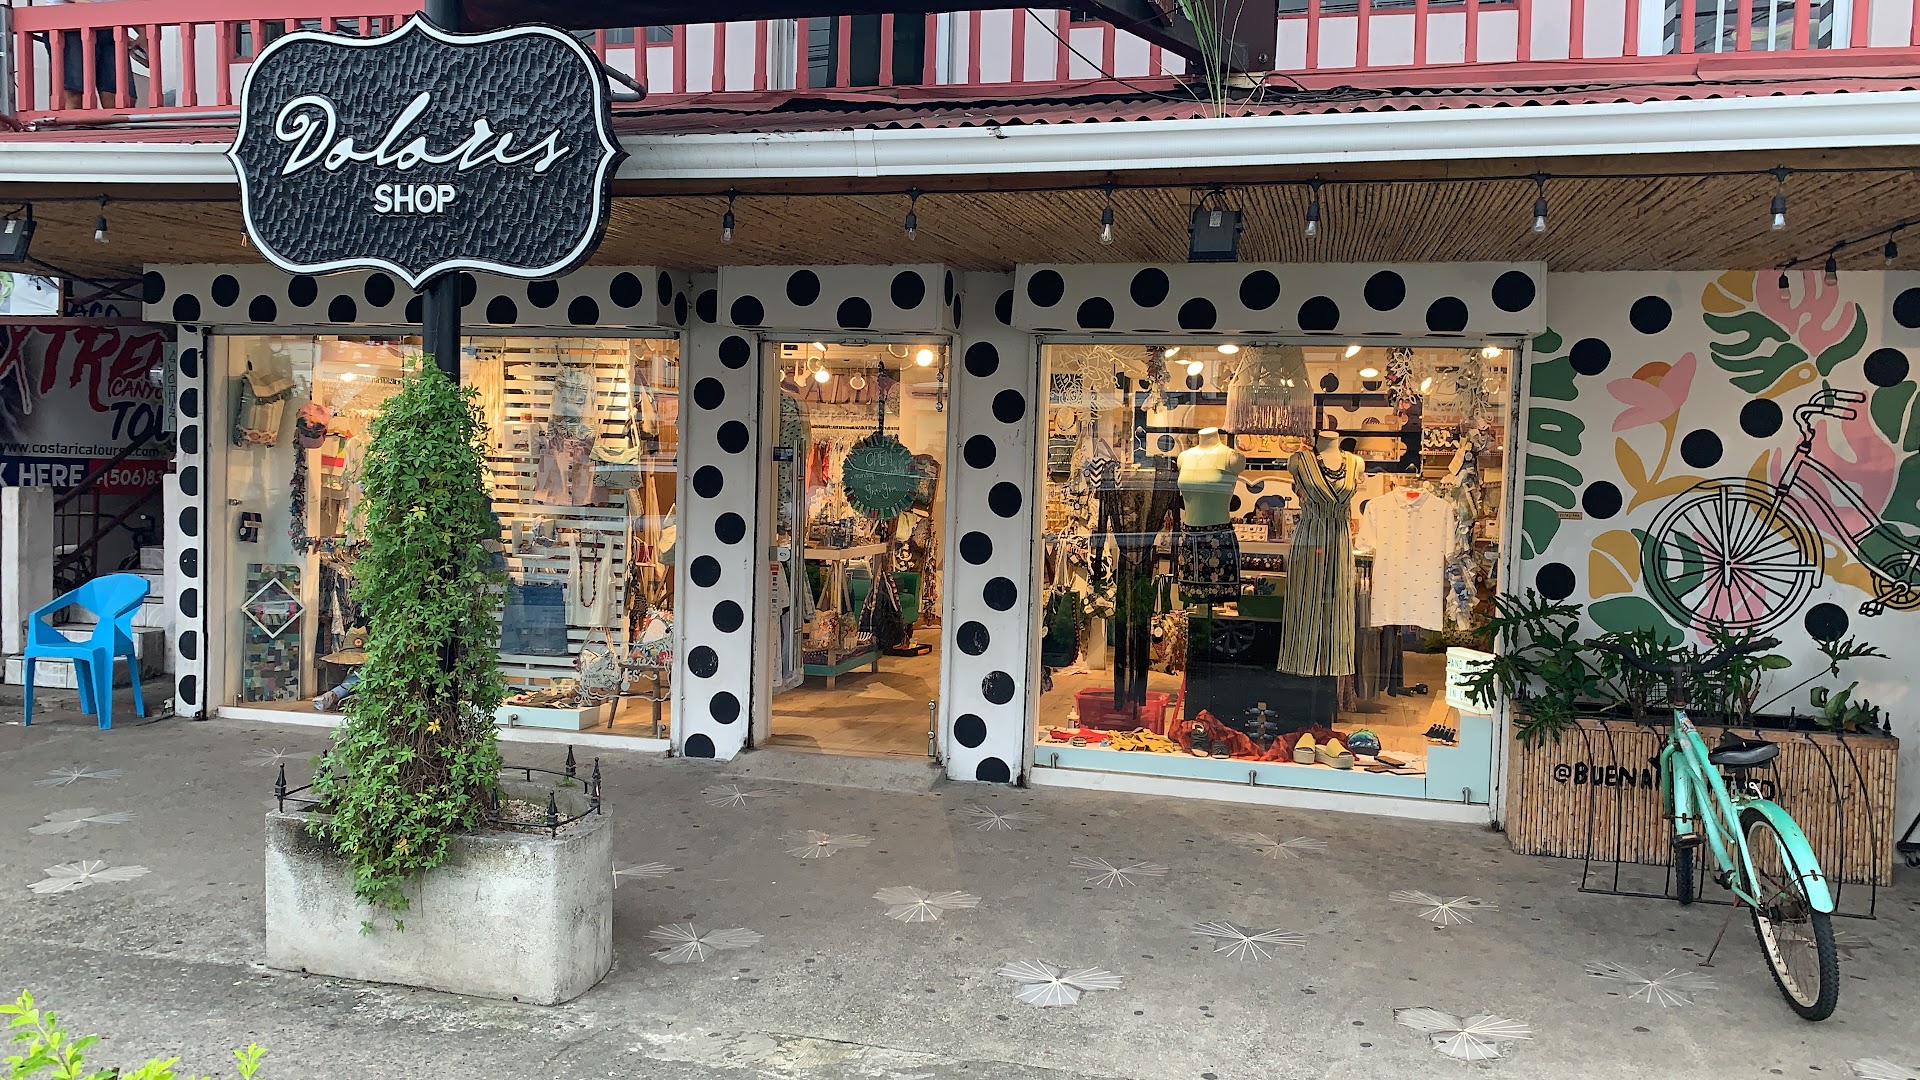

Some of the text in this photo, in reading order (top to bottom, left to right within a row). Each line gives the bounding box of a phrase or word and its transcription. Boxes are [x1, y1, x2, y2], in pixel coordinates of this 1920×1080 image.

[275, 91, 570, 176] Dolores
[373, 183, 456, 214] SHOP
[111, 401, 176, 442] TOU
[0, 442, 161, 458] www.costaricatours.com
[865, 450, 894, 467] OPEN
[19, 463, 85, 488] HERE
